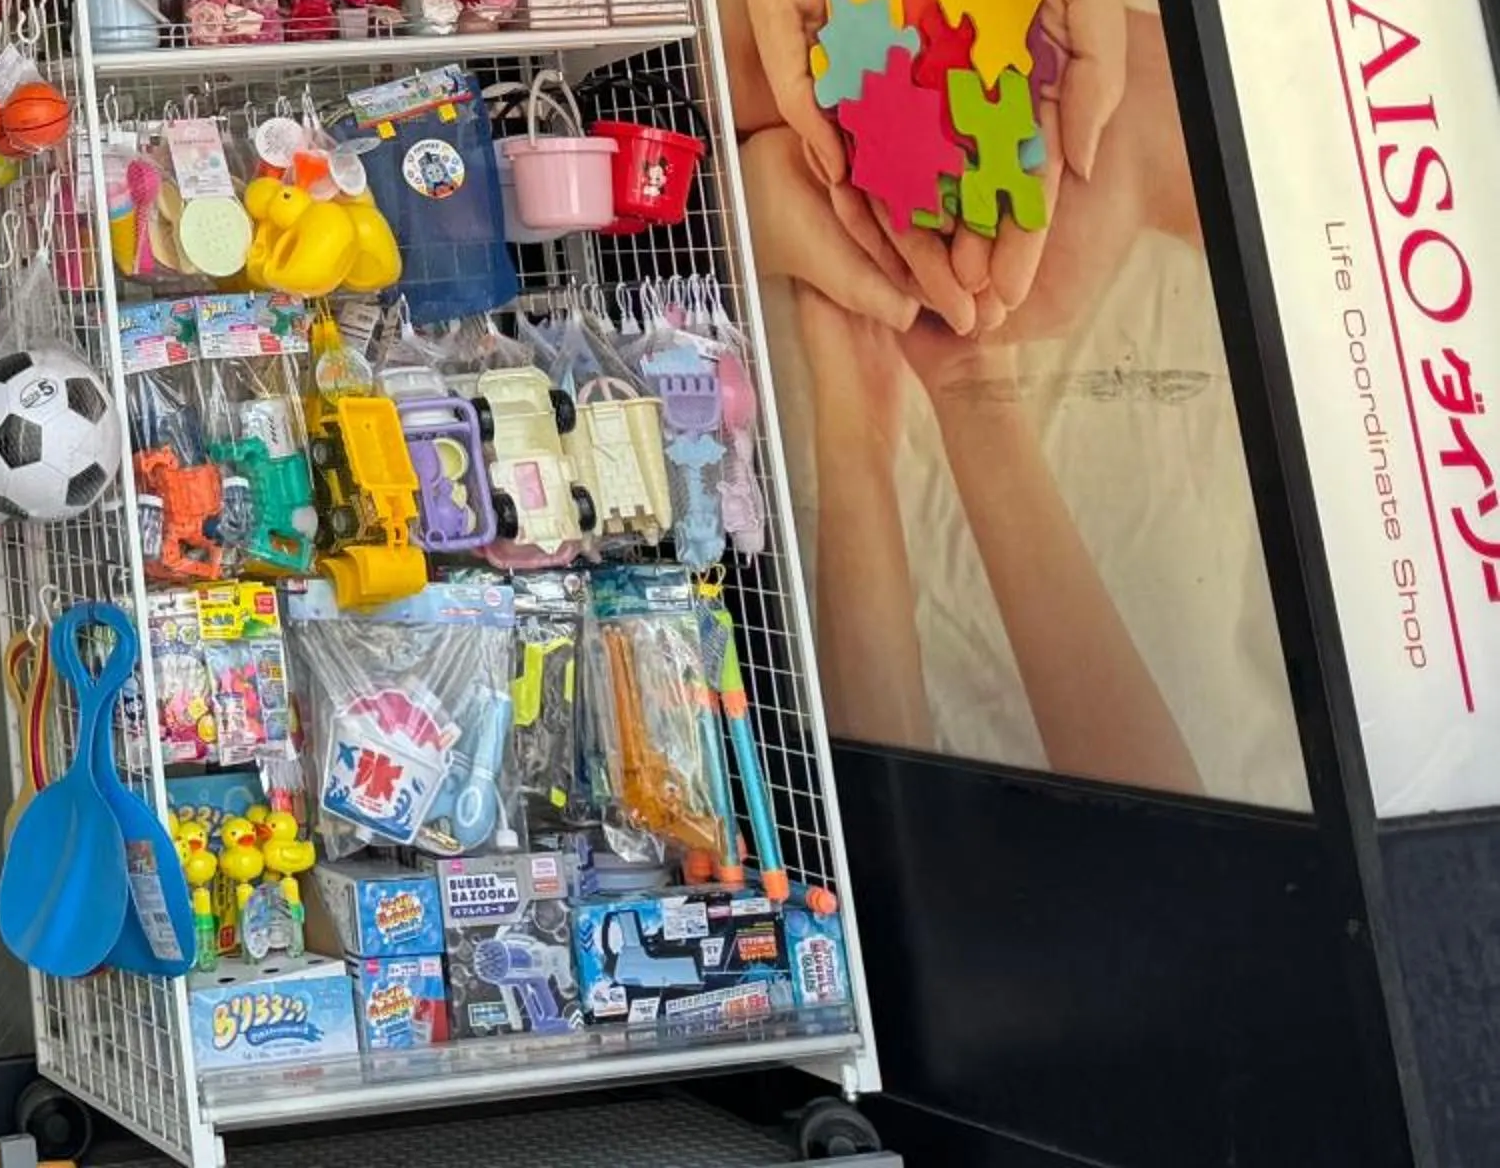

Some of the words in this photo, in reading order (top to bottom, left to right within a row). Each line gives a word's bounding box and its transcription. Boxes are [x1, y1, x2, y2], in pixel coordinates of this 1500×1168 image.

[37, 381, 55, 396] 5
[1324, 220, 1353, 291] Life
[1343, 308, 1402, 541] Coordinate
[1392, 558, 1428, 670] Shop
[1421, 346, 1500, 606] ダイソー
[450, 876, 496, 890] BUBBLE
[451, 887, 517, 903] BAZOOKA
